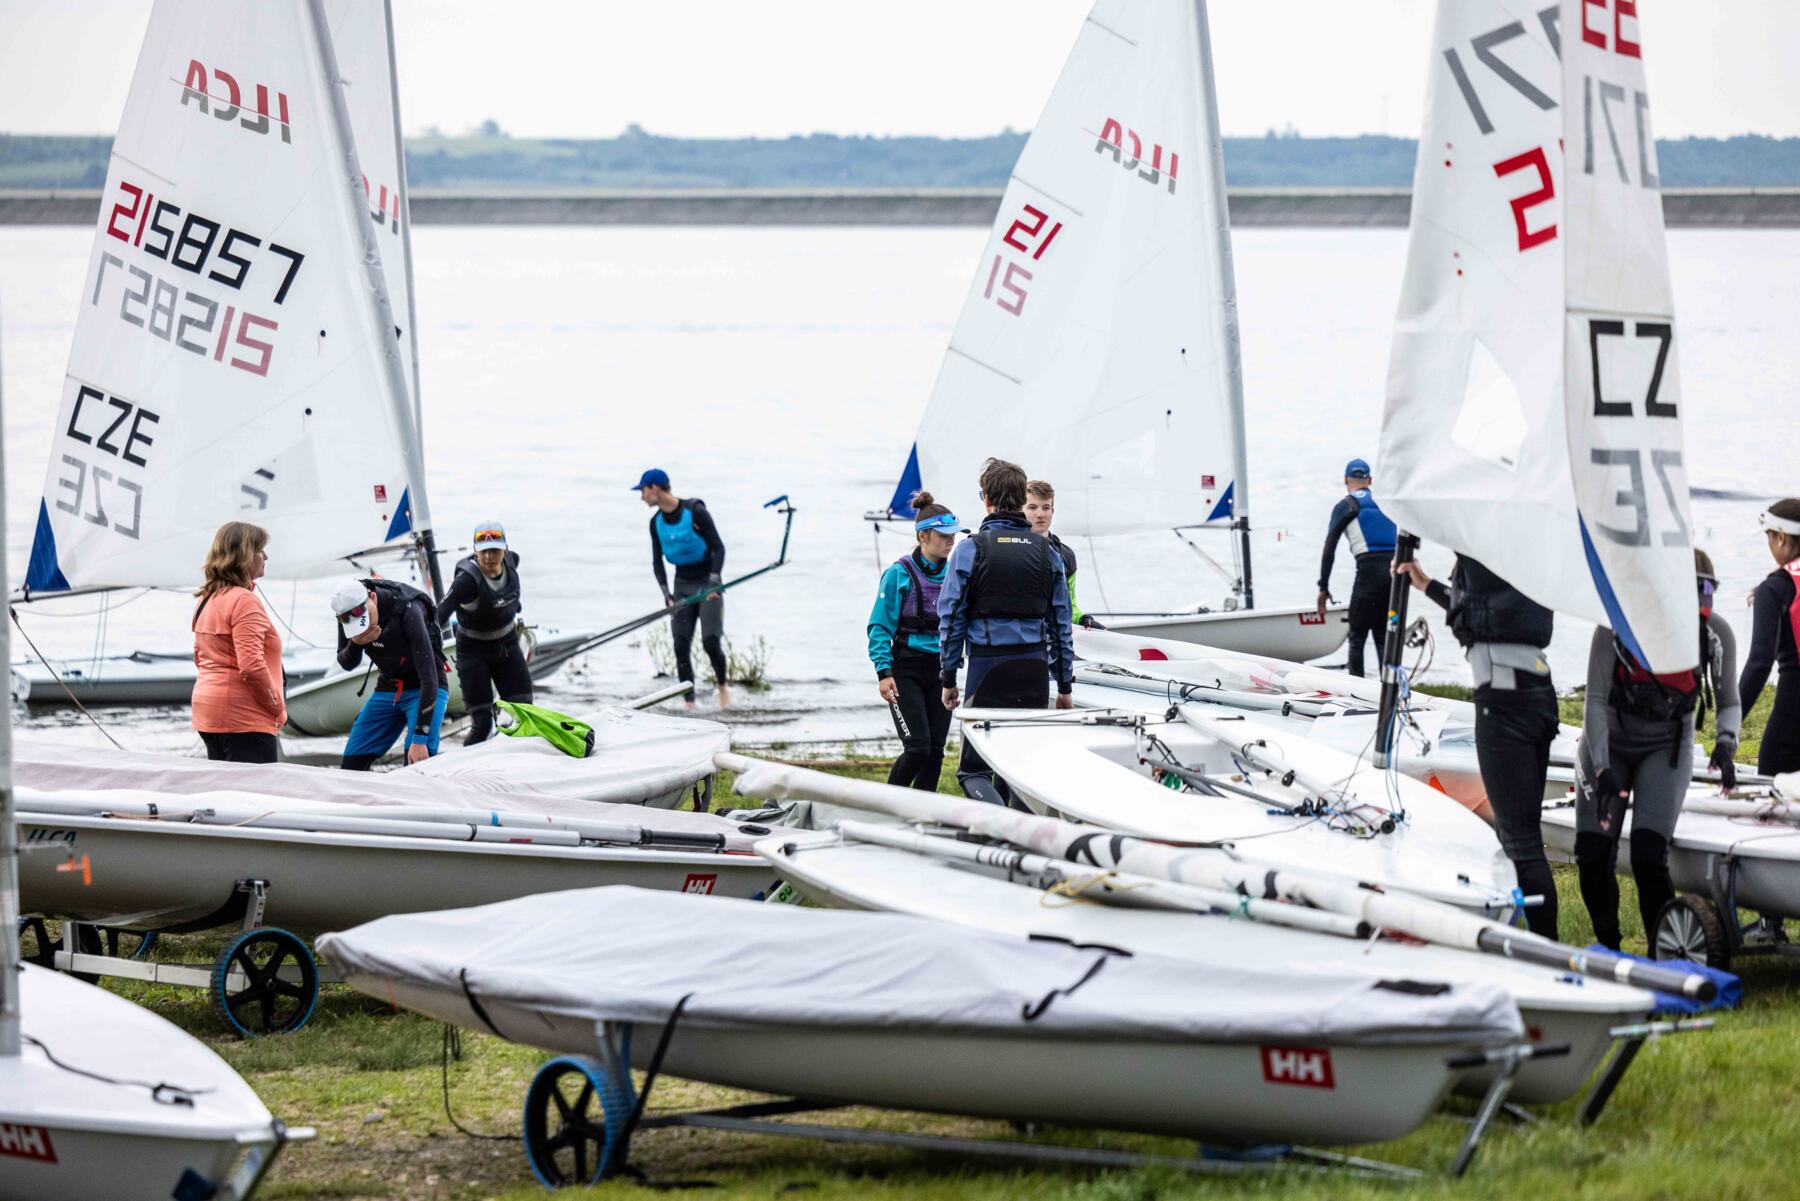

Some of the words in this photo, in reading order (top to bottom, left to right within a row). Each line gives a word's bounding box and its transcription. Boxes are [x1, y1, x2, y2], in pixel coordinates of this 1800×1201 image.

[1492, 138, 1564, 253] 2
[107, 181, 305, 305] 215857
[1003, 204, 1063, 260] 21
[67, 385, 160, 467] CZE
[1269, 1049, 1325, 1082] HH
[0, 1124, 47, 1156] HH
